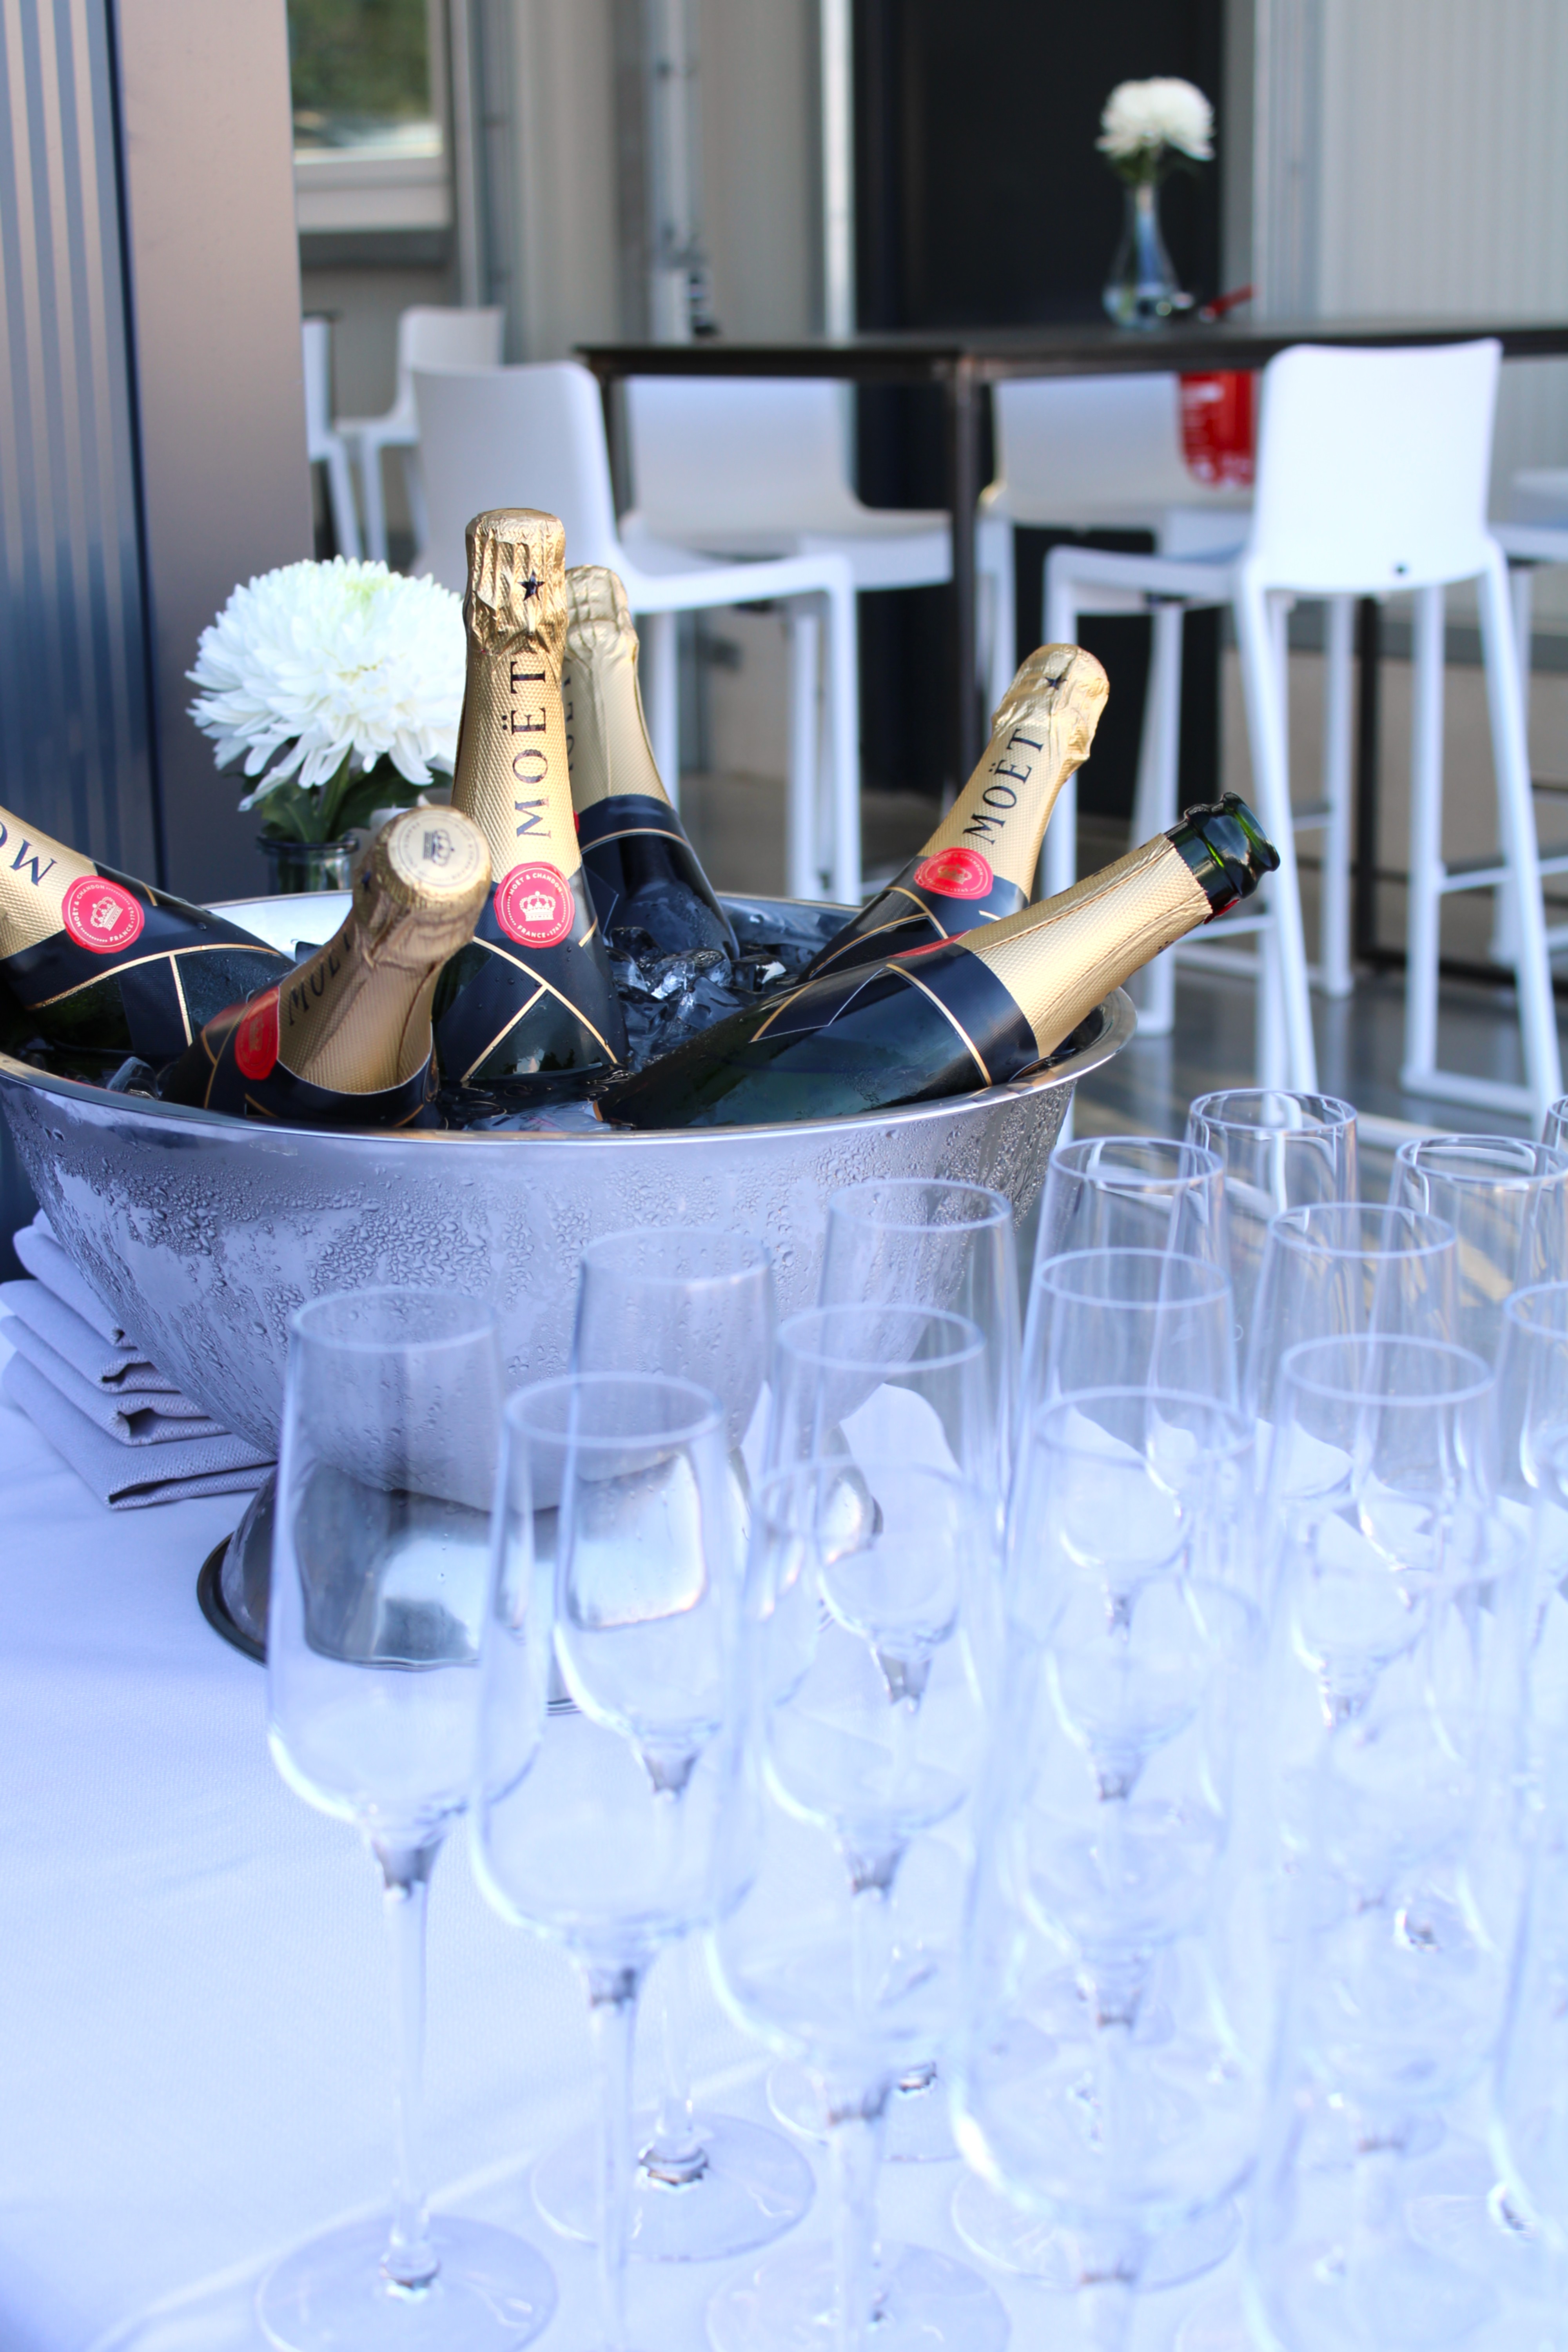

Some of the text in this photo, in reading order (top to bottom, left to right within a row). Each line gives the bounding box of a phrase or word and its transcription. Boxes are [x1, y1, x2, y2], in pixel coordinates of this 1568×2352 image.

[502, 661, 551, 838] MOËT
[963, 729, 1043, 845] MOËT
[0, 820, 58, 886] M
[77, 884, 105, 900] CHANDON
[532, 873, 563, 893] CHANDON
[109, 924, 134, 942] FRANCE
[517, 925, 546, 938] FRANCE
